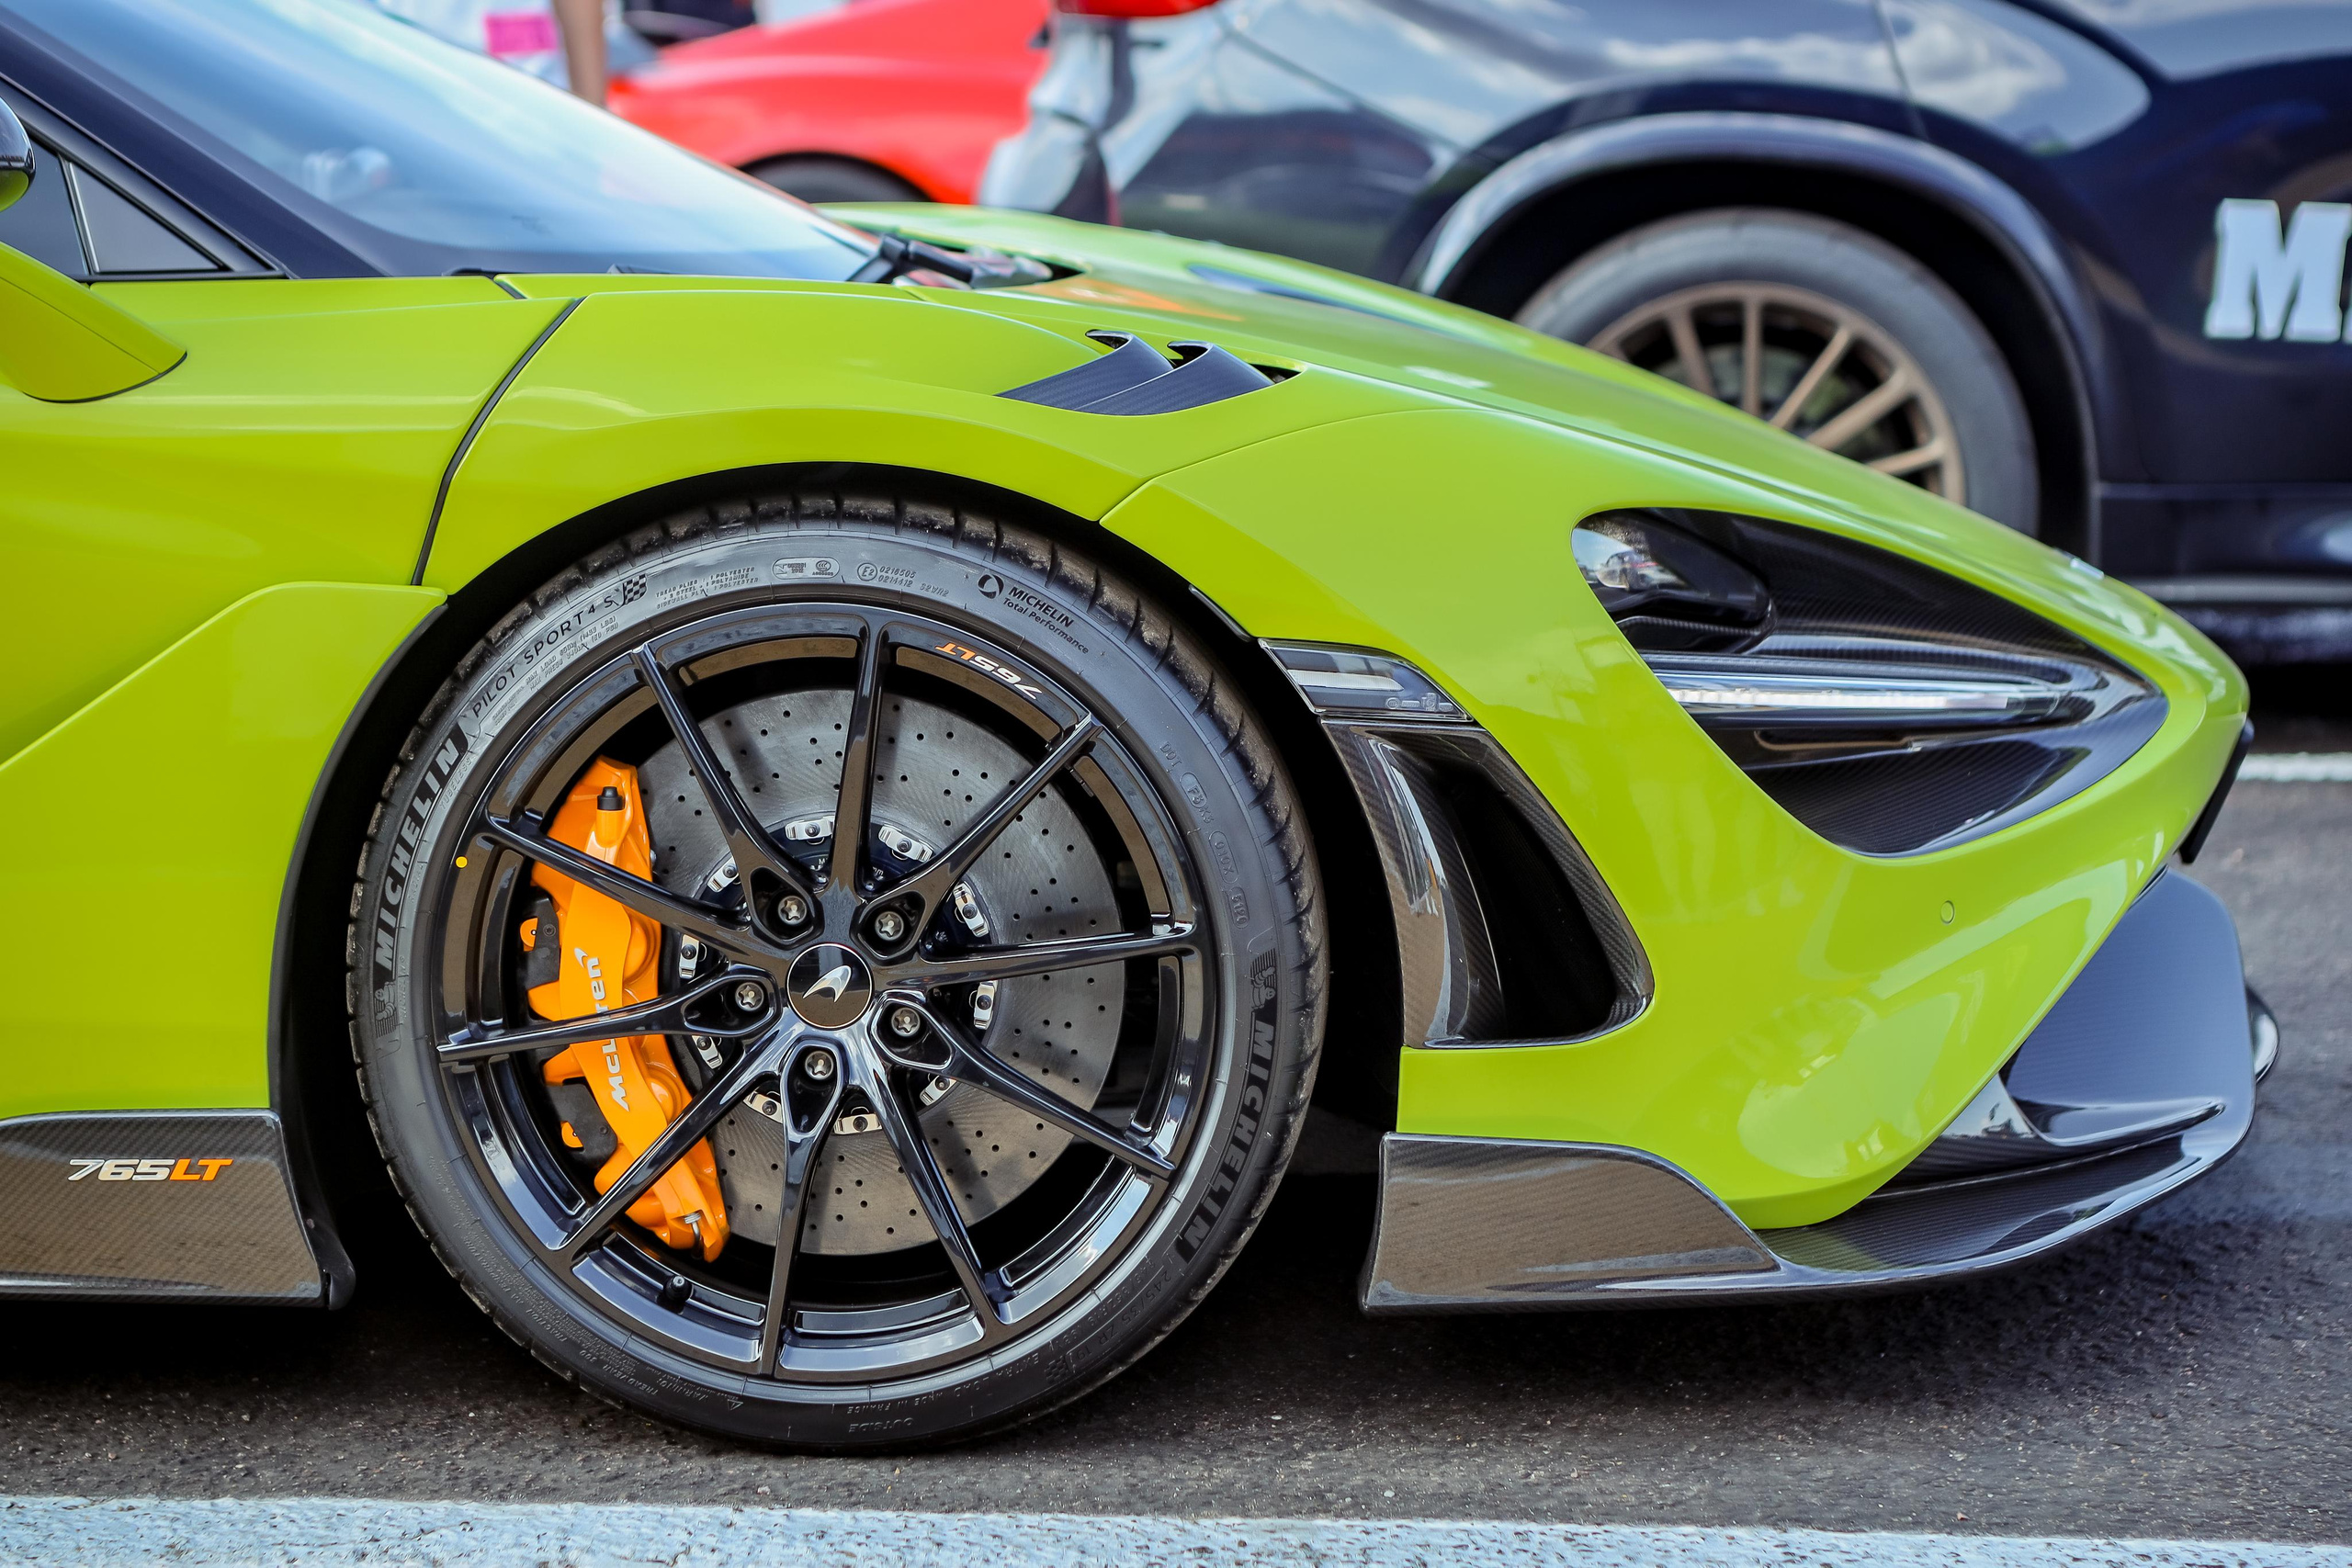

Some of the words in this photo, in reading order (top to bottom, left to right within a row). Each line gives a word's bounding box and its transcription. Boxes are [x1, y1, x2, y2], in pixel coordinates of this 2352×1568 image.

[2203, 197, 2352, 343] M
[715, 566, 754, 578] POLYESTER
[1001, 597, 1028, 614] Total
[1027, 610, 1091, 654] Performance
[1007, 585, 1074, 627] MICHELIN
[469, 662, 519, 717] PILOT
[521, 609, 586, 665] SPORT
[934, 641, 1043, 700] 765LT
[1159, 740, 1183, 769] DOT
[374, 737, 461, 970] MICHELIN
[1183, 1021, 1273, 1248] MICHELIN
[67, 1157, 234, 1182] 765LT
[460, 1235, 512, 1292] TEMPERATURE
[1119, 1269, 1173, 1326] 245/35
[525, 1307, 568, 1343] TRACTION
[1095, 1324, 1119, 1347] ZR
[1073, 1345, 1093, 1363] 19
[601, 1363, 659, 1395] TREADWEAR
[846, 1401, 889, 1414] FRANCE
[848, 1416, 912, 1433] OUTSIDE
